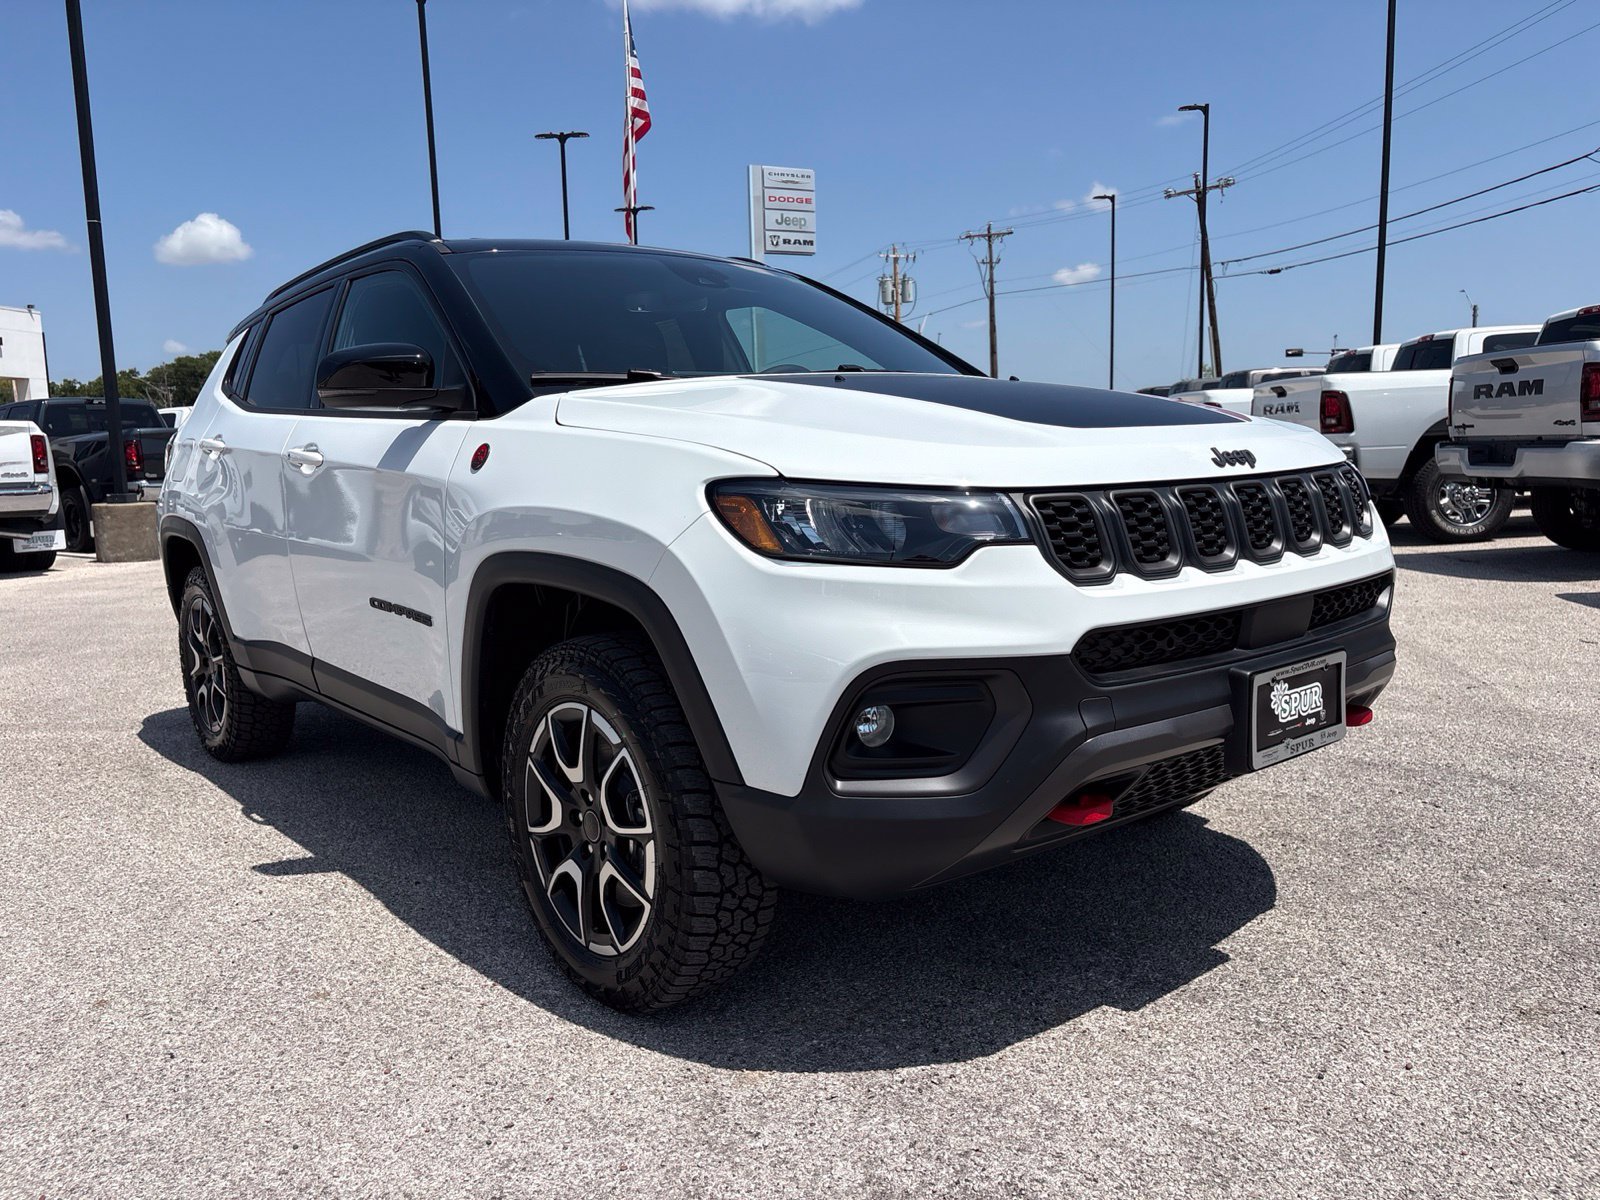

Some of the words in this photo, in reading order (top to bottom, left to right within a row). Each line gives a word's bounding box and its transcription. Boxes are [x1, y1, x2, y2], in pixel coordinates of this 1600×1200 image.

[768, 171, 811, 179] CHRYSLER
[768, 195, 812, 204] DODGE
[775, 213, 807, 229] Jeep
[782, 238, 814, 246] RAM
[1474, 379, 1544, 400] RAM
[1263, 401, 1300, 415] RAM
[1210, 446, 1256, 469] Jeep
[369, 597, 432, 627] COMPASS
[1280, 685, 1323, 720] SPUR
[1290, 738, 1315, 755] SPUR
